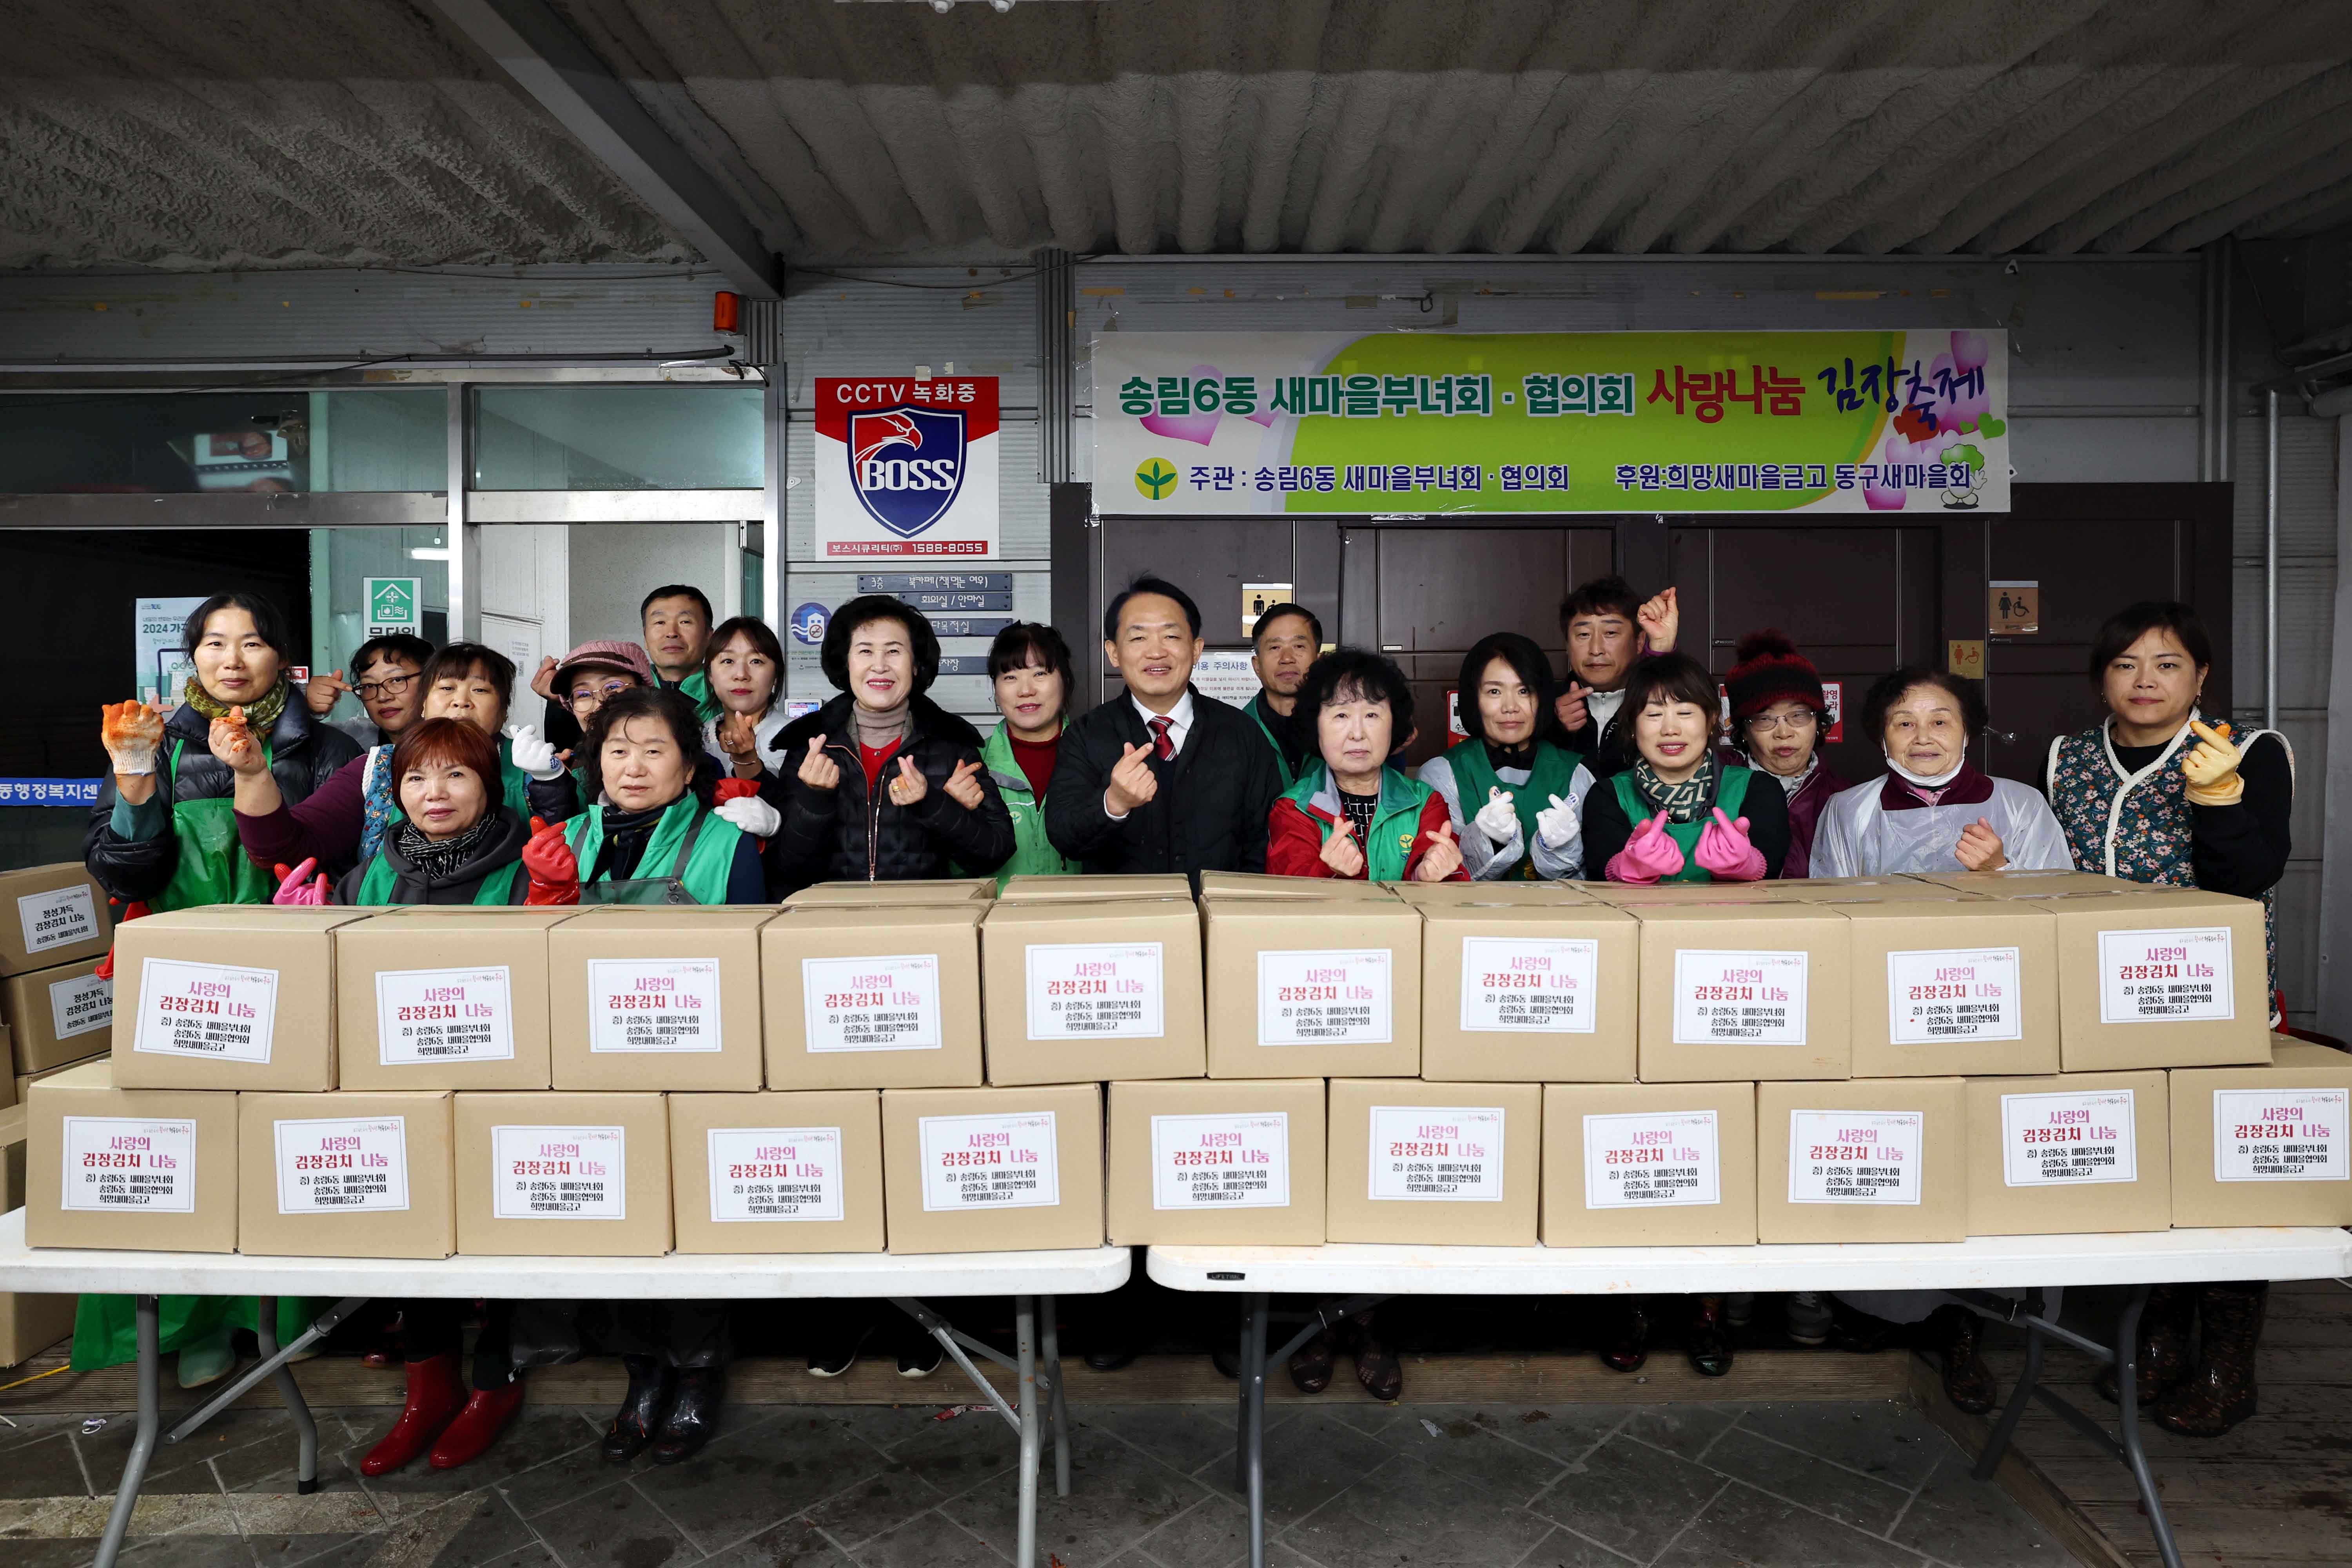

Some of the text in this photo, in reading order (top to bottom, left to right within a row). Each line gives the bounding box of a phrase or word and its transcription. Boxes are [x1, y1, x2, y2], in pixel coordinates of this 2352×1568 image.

[837, 383, 976, 403] CCTV 녹화중
[1120, 377, 1258, 415] 송림6동
[1270, 376, 1490, 415] 새마을부녀회
[1525, 375, 1633, 414] 협의회
[1647, 365, 1806, 423] 사랑나눔
[1817, 357, 1985, 431] 김장축제
[862, 459, 955, 491] BOSS
[1189, 466, 1234, 491] 주관
[1254, 466, 1336, 492] 송림6동
[1343, 465, 1481, 491] 새마을부녀회
[1501, 465, 1568, 490] 협의회
[1616, 464, 1971, 490] 후원:희망새마을금고 동구새마을회
[832, 543, 982, 553] 보스시큐리티(주) 1588-8055
[871, 577, 883, 590] 3층
[969, 575, 988, 588] 여우)
[922, 595, 947, 608] 회의실
[958, 595, 985, 608] 안마실
[143, 624, 168, 633] 2024
[931, 621, 969, 633] 다목적실
[1213, 661, 1248, 671] 주의사항
[0, 783, 102, 800] 동행정복지센
[42, 904, 74, 919] 정성가득
[35, 913, 85, 931] 김장김치 나눔
[36, 925, 89, 945] 송림6동 새마을부녀회
[1075, 962, 1116, 976] 사랑의
[1510, 957, 1551, 970] 사랑의
[1483, 973, 1577, 988] 김장김치 나눔
[1934, 967, 1975, 981] 사랑의
[188, 981, 230, 998] 사랑의
[634, 977, 675, 992] 사랑의
[1047, 980, 1143, 995] 김장김치 나눔
[2123, 983, 2211, 995] 증) 송림6동 새마을부녀회
[73, 987, 104, 1003] 정성가득
[1908, 983, 2002, 1000] 김장김치 나눔
[608, 994, 701, 1009] 김장김치 나눔
[2138, 994, 2212, 1005] 송림6동 새마을협의회
[66, 1000, 96, 1016] 김장김치
[160, 995, 256, 1018] 김장김치 나눔
[1281, 1006, 1370, 1017] 증) 송림6동 새마을부녀회
[1697, 1007, 1785, 1017] 증) 송림6동 새마을부녀회
[88, 1010, 113, 1022] 새마을부녀
[829, 1011, 918, 1024] 증) 송림6동 새마을부녀회
[1296, 1016, 1370, 1027] 송림6동 새마을협의회
[1499, 1014, 1550, 1025] 희망새마을금고
[1711, 1018, 1785, 1027] 송림6동 새마을협의회
[402, 1023, 490, 1036] 증) 송림6동 새마을부녀회
[843, 1022, 918, 1034] 송림6동 새마을협의회
[1066, 1022, 1118, 1031] 희망새마을금고
[1927, 1025, 1978, 1035] 희망새마을금고
[173, 1038, 225, 1052] 희망새마을금고
[417, 1034, 491, 1046] 송림6동 새마을협의회
[627, 1036, 677, 1045] 희망새마을금고
[2048, 1109, 2089, 1124] 사랑의
[2261, 1107, 2303, 1121] 사랑의
[1417, 1125, 1458, 1140] 사랑의
[1836, 1129, 1877, 1143] 사랑의
[2023, 1126, 2117, 1143] 김장김치 나눔
[2234, 1123, 2330, 1139] 김장김치 나눔
[109, 1136, 150, 1151] 사랑의
[968, 1132, 1010, 1148] 사랑의
[539, 1144, 579, 1158] 사랑의
[1390, 1142, 1485, 1157] 김장김치 나눔
[1809, 1145, 1904, 1161] 김장김치 나눔
[82, 1152, 177, 1169] 김장김치 나눔
[942, 1149, 1038, 1167] 김장김치 나눔
[512, 1161, 606, 1175] 김장김치 나눔
[1609, 1167, 1697, 1180] 증) 송림6동 새마을부녀회
[2042, 1167, 2093, 1178] 희망새마을금고
[2252, 1165, 2305, 1174] 희망새마을금고
[299, 1173, 386, 1185] 증) 송림6동 새마을부녀회
[1177, 1170, 1267, 1181] 증) 송림6동 새마을부녀회
[314, 1184, 387, 1196] 송림6동 새마을협의회
[733, 1184, 821, 1194] 증) 송림6동 새마을부녀회
[1192, 1180, 1267, 1192] 송림6동 새마을협의회
[1406, 1183, 1457, 1193] 희망새마을금고
[1623, 1178, 1698, 1190] 송림6동 새마을협의회
[962, 1191, 1013, 1202] 희망새마을금고
[1826, 1187, 1877, 1196] 희망새마을금고
[99, 1194, 150, 1204] 희망새마을금고
[748, 1194, 821, 1205] 송림6동 새마을협의회
[530, 1202, 581, 1212] 희망새마을금고
